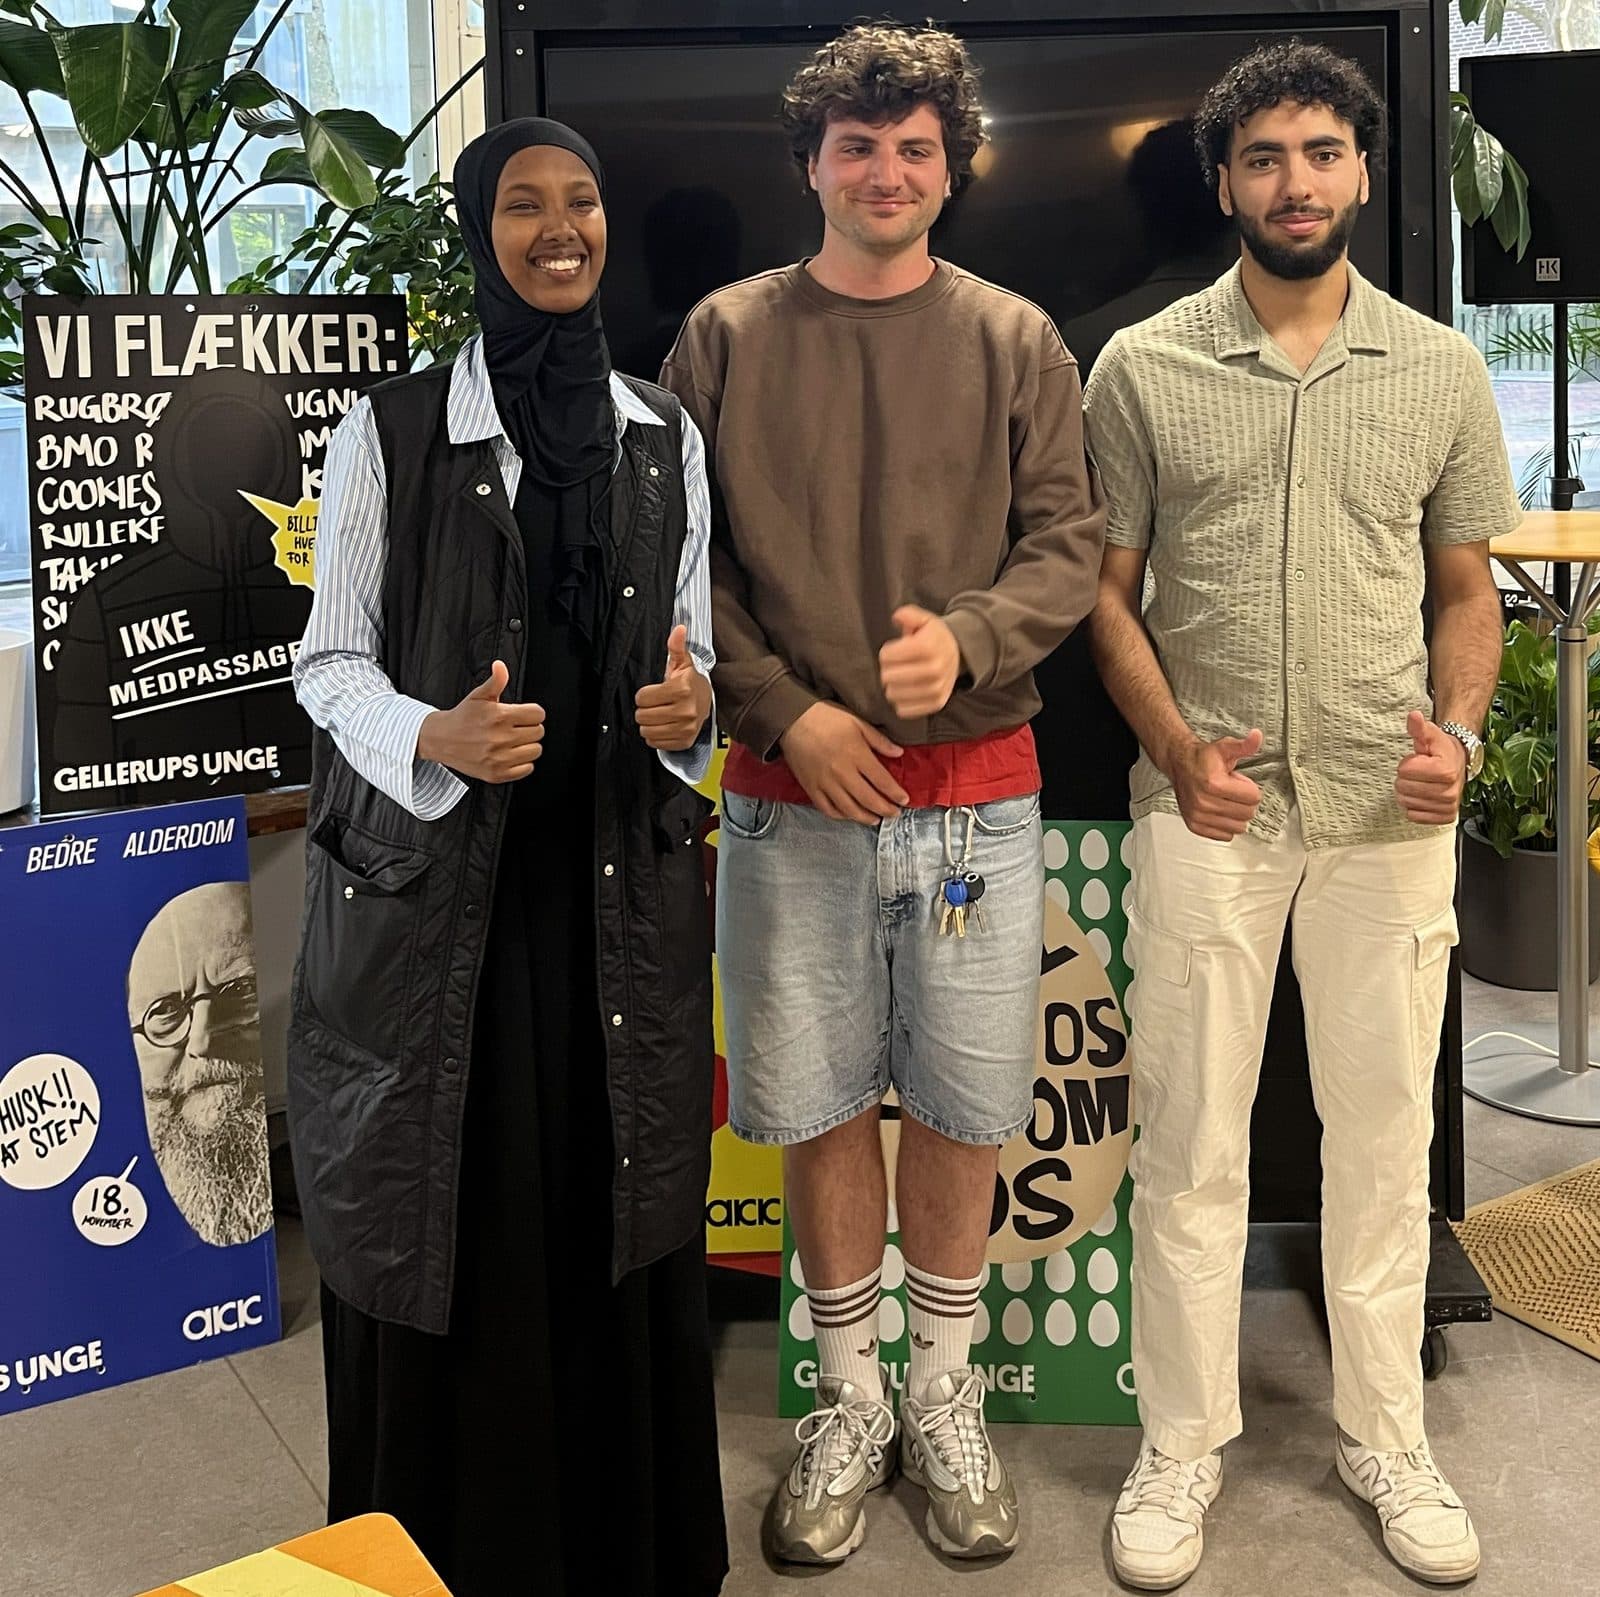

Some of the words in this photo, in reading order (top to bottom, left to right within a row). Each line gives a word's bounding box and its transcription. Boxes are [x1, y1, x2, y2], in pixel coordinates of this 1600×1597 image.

[35, 315, 92, 379] VI
[114, 313, 398, 377] FLÆKKER:
[37, 470, 162, 516] COOKIES
[119, 609, 195, 658] IKKE
[53, 754, 199, 792] GELLERUPS
[202, 746, 278, 776] UNGE
[26, 837, 99, 873] BEDRE
[122, 817, 236, 859] ALDERDOM
[0, 1067, 77, 1134] HUSK!!
[29, 1102, 98, 1159] STEM
[81, 1214, 134, 1230] NOVEMBER
[91, 1184, 130, 1216] 18.
[15, 1340, 103, 1386] UNGE
[967, 1363, 1035, 1393] NGE
